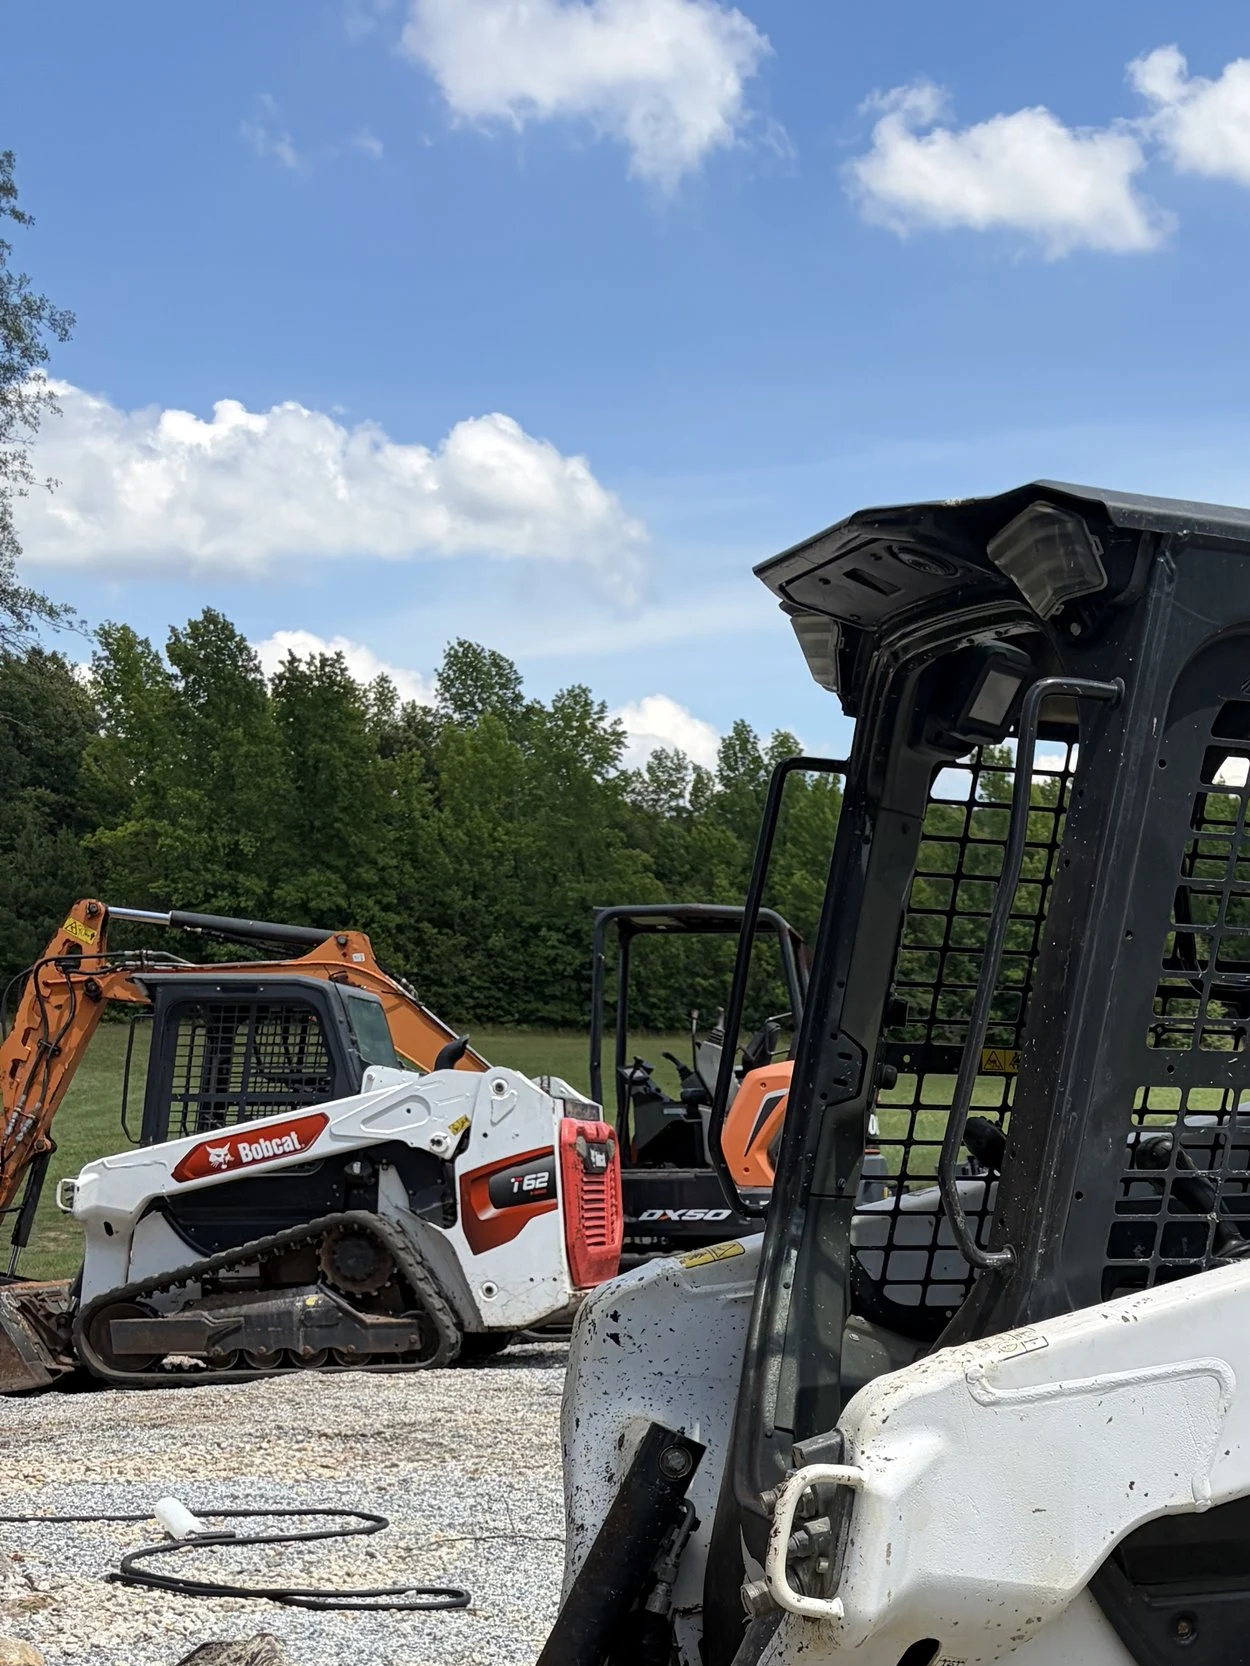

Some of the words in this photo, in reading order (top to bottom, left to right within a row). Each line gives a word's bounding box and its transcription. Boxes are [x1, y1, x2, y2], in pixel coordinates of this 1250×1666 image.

[237, 1131, 301, 1163] Bobcat
[510, 1172, 549, 1193] T62
[638, 1209, 732, 1220] DX50
